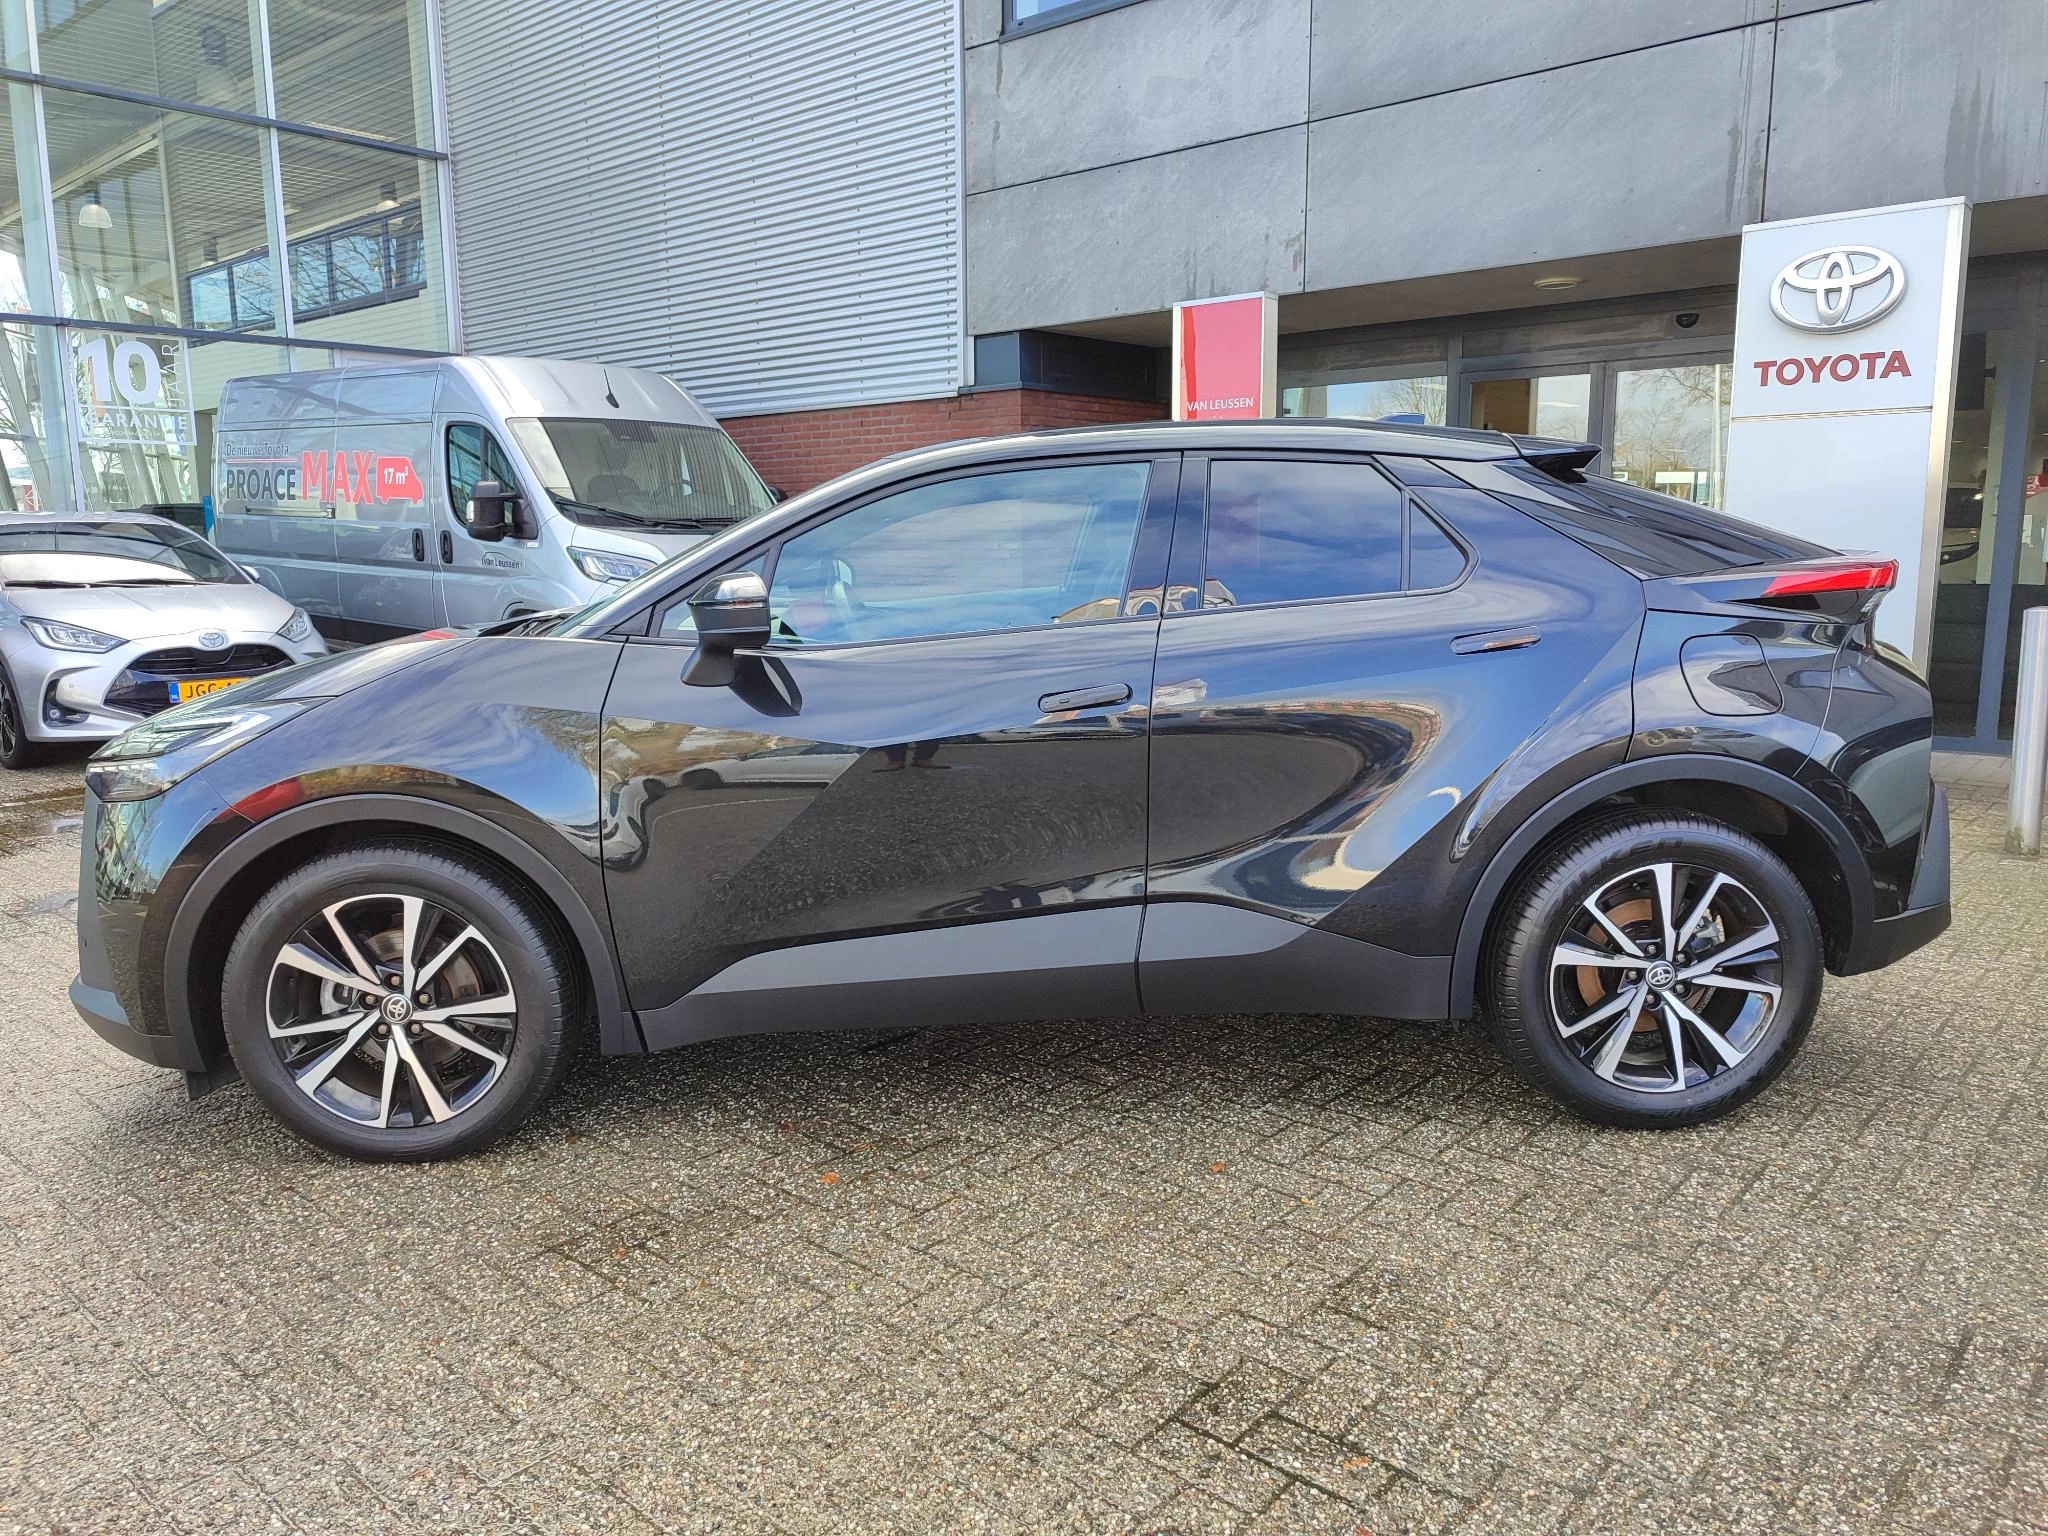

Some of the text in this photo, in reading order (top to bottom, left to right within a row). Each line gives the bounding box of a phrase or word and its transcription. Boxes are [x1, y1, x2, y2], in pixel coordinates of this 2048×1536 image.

[78, 339, 161, 404] 10
[162, 341, 186, 407] JAAR
[1754, 350, 1912, 387] TOYOTA
[1186, 397, 1254, 411] VAN LEUSSEN
[226, 443, 236, 456] De
[264, 442, 289, 457] Toyota
[226, 450, 374, 505] PROACE MAX
[383, 468, 395, 485] 17
[483, 557, 520, 569] van Leussen
